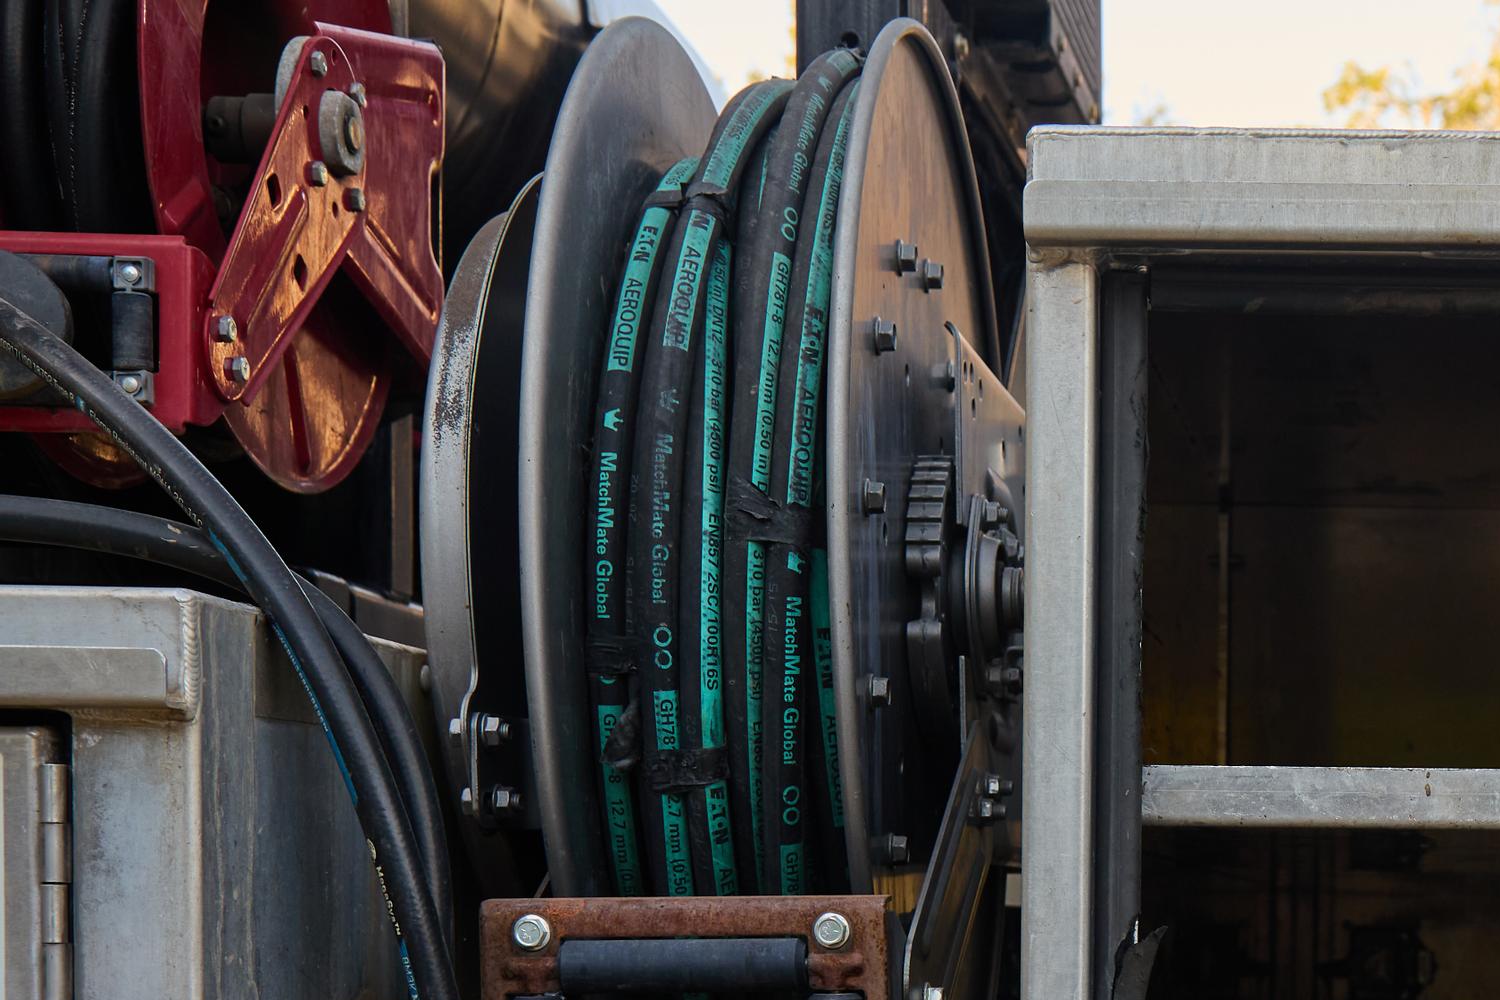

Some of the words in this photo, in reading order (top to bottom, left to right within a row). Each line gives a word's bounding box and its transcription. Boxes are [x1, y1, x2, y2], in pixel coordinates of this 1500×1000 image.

[611, 277, 642, 367] AEROQUIP
[667, 245, 702, 347] AEROQUIP
[769, 260, 791, 326] GH781-8
[765, 337, 781, 370] 12.7
[707, 387, 723, 413] bar
[761, 370, 776, 406] mm
[706, 416, 722, 461] (4500
[758, 407, 773, 451] (0.50
[791, 386, 816, 507] AEROQUIP
[596, 451, 618, 556] MatchMate
[652, 434, 674, 539] MatchMate
[706, 512, 724, 571] EN857
[752, 550, 766, 582] 310
[596, 558, 614, 619] Global
[652, 543, 671, 605] Global
[752, 585, 765, 613] bar
[703, 572, 721, 693] 2SC/100R16S
[751, 617, 765, 667] (4500
[783, 595, 803, 703] MatchMate
[783, 706, 800, 765] Global
[610, 798, 627, 830] 12.7
[669, 823, 683, 854] mm
[615, 834, 630, 864] mm
